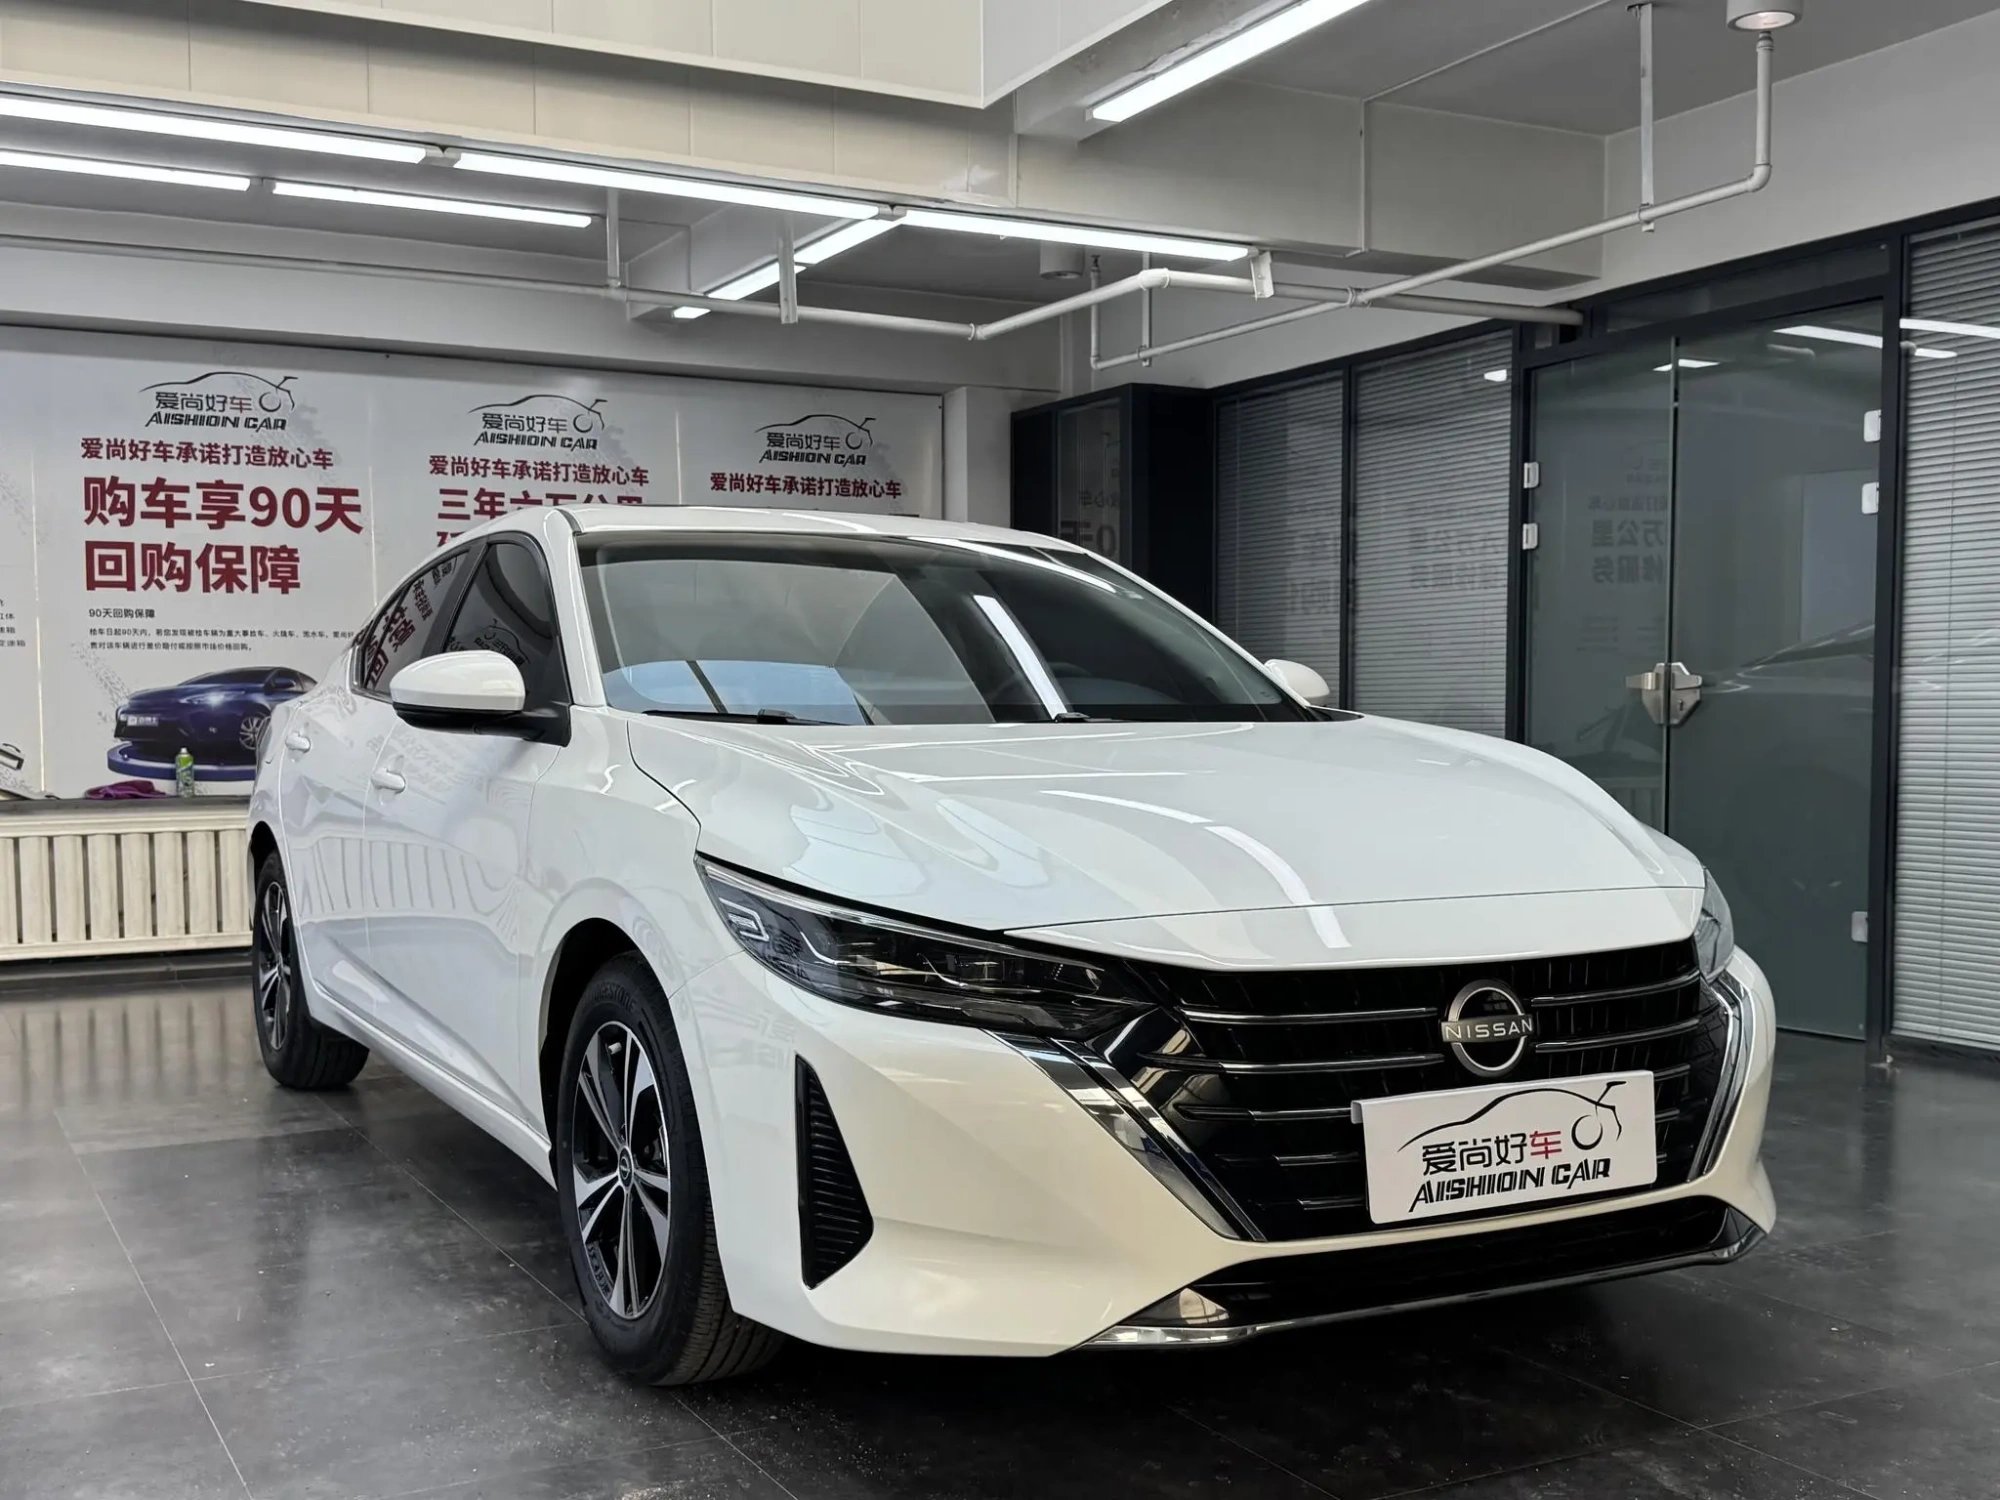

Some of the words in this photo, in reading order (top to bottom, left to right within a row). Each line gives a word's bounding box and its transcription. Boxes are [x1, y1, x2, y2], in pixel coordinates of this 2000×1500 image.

[155, 391, 252, 413] 爱尚好车
[145, 411, 240, 427] AISHION
[243, 416, 287, 433] CAR
[482, 412, 567, 433] 爱尚好车
[473, 431, 556, 447] AISHION
[560, 437, 598, 452] CAR
[767, 432, 840, 451] 爱尚好车
[81, 437, 334, 470] 爱尚好车承诺打造放心车
[758, 449, 832, 465] AISHION
[833, 454, 867, 468] CAR
[429, 454, 649, 486] 爱尚好车承诺打造放心车
[710, 472, 902, 499] 爱尚好车承诺打造放心车
[84, 475, 363, 534] 购车享90天
[85, 540, 301, 594] 回购保障
[88, 608, 155, 619] 90天回购保障
[1445, 1018, 1533, 1039] NISSAN
[1422, 1130, 1562, 1176] 爱尚好车
[1408, 1166, 1546, 1213] AISHION
[1551, 1158, 1611, 1190] CAR
